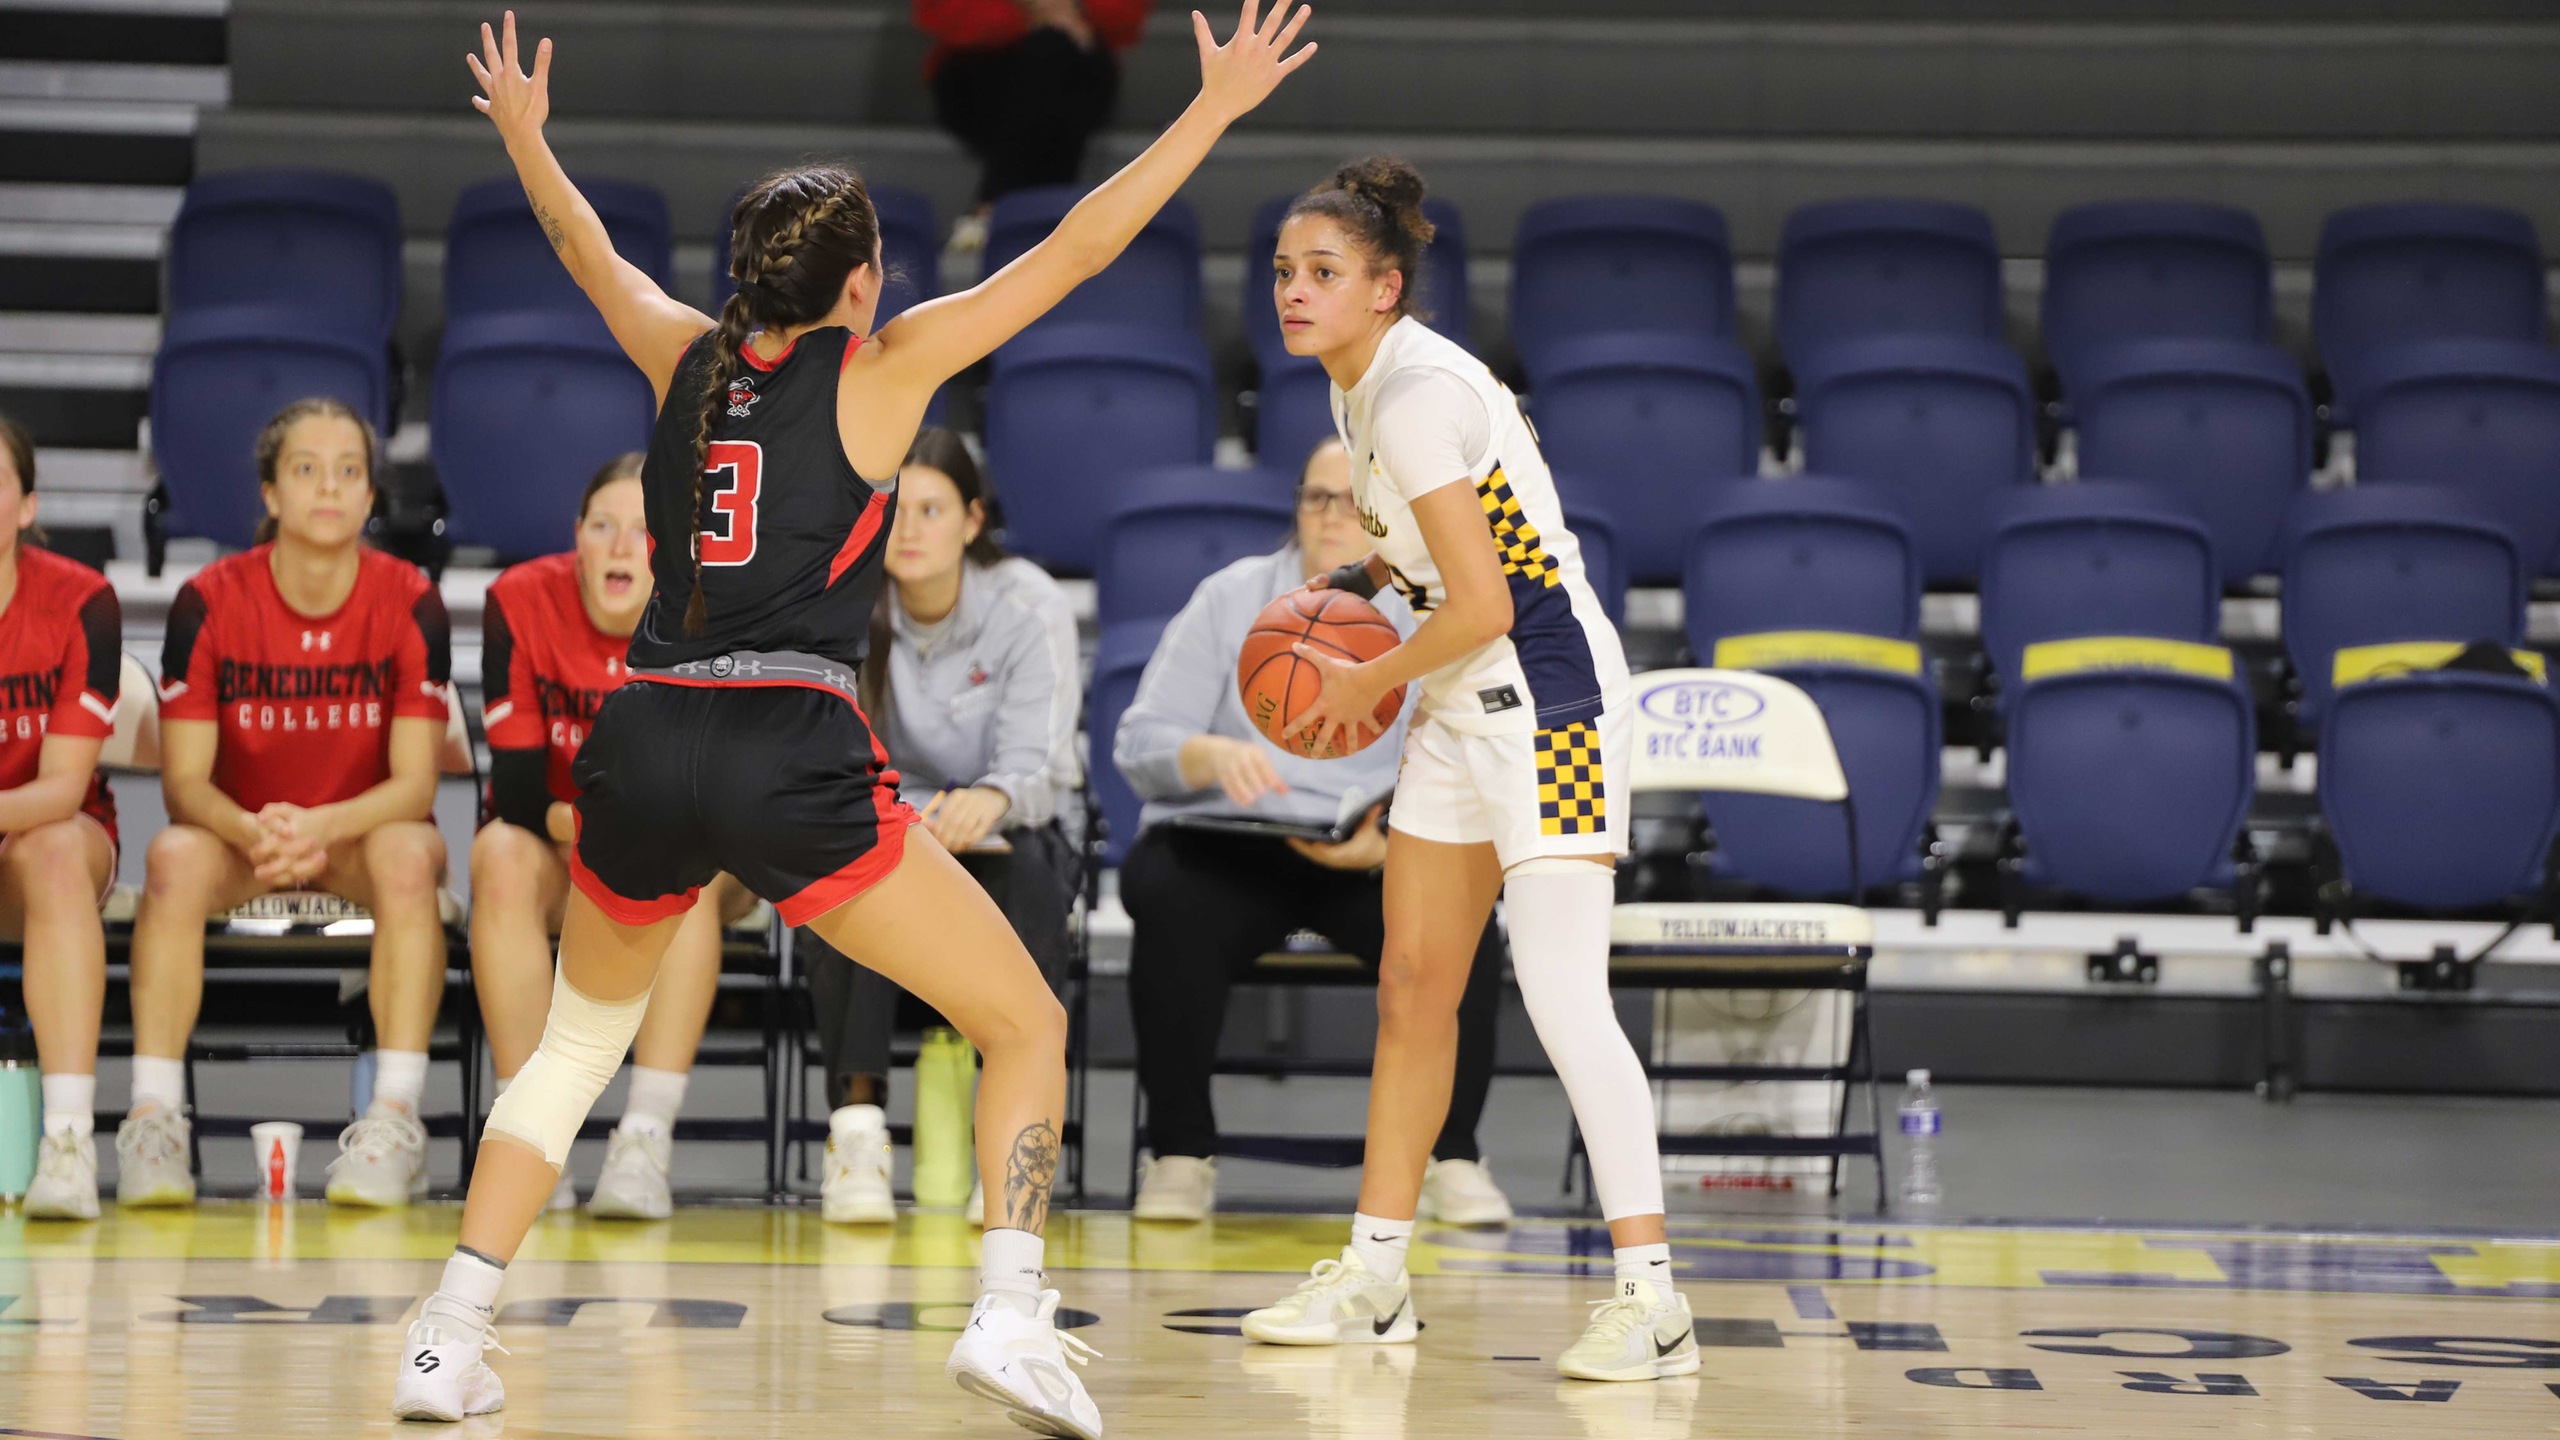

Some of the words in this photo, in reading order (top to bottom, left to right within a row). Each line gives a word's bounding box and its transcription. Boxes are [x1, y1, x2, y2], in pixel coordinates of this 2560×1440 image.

[690, 440, 763, 567] 3
[1674, 688, 1731, 716] BTC
[238, 702, 382, 731] COLLEGE
[1647, 732, 1689, 757] BTC
[1697, 732, 1763, 758] BANK
[1660, 918, 1830, 940] YELLOWJACKETS
